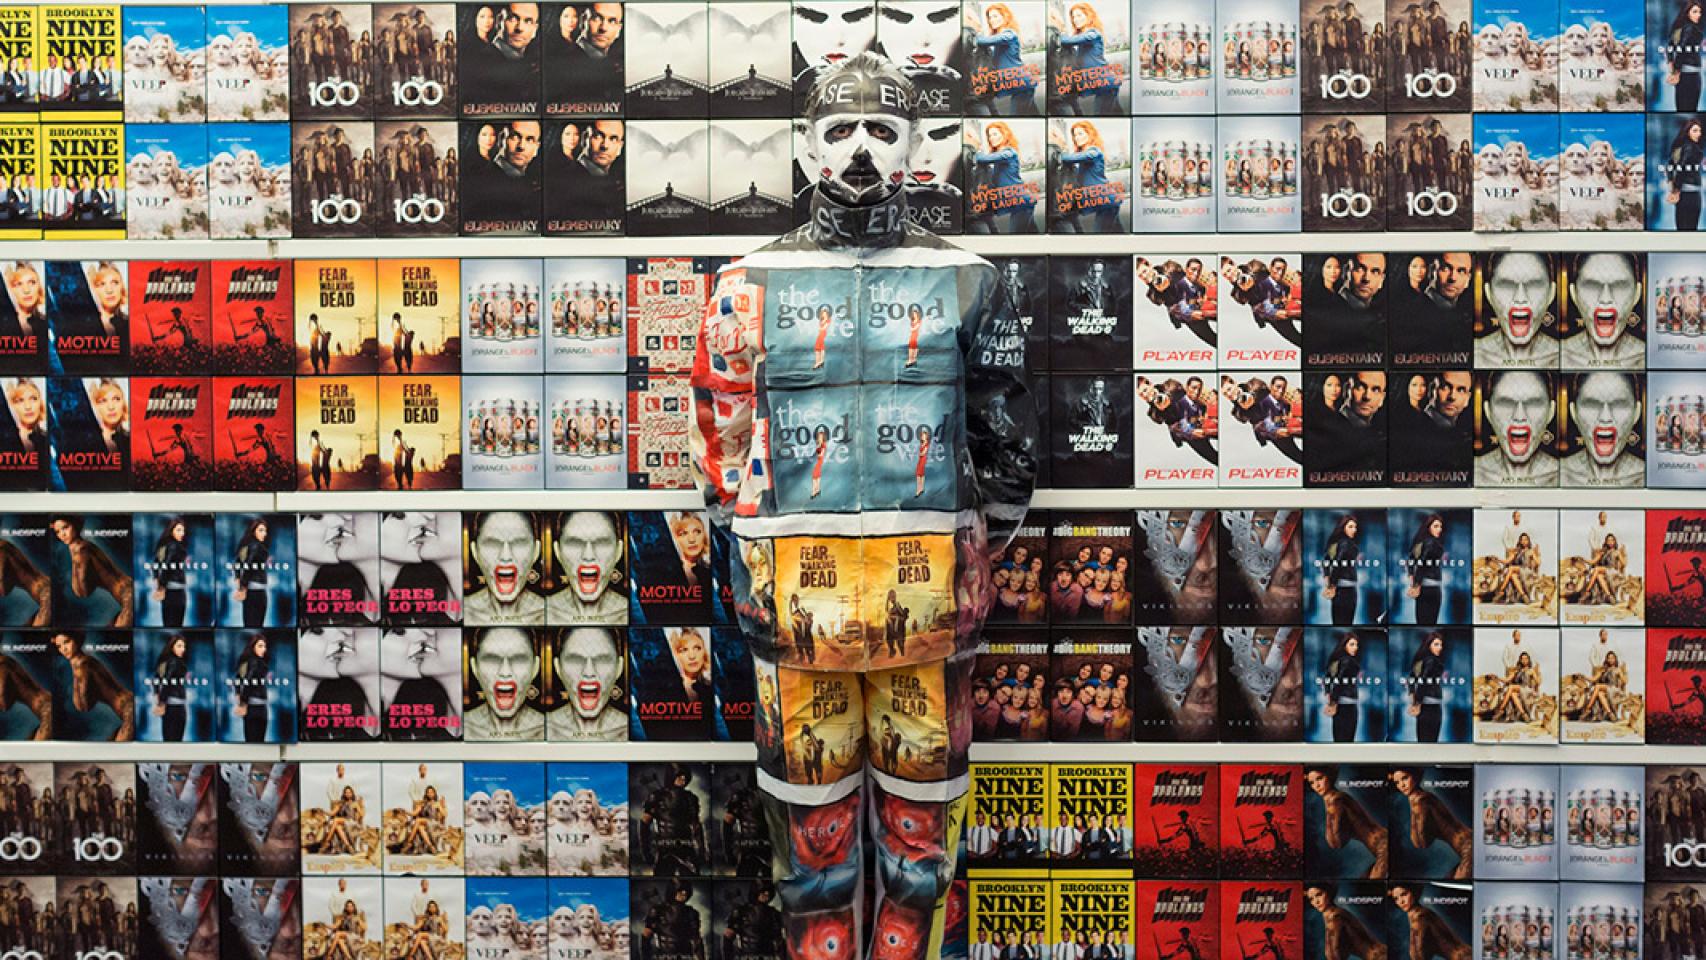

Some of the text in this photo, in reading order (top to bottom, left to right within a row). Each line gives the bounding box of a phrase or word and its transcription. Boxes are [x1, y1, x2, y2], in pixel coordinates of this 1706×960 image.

[48, 20, 115, 36] NINE
[48, 40, 115, 56] NINE
[1485, 69, 1519, 78] VEEP
[1570, 69, 1604, 78] VEEP
[132, 80, 166, 89] VEEP
[216, 79, 250, 89] VEEP
[992, 80, 1026, 91] LAURA
[1058, 80, 1109, 95] OF LAURA
[1321, 74, 1370, 99] 100
[1406, 73, 1456, 98] 100
[309, 82, 359, 106] 100
[393, 81, 443, 106] 100
[464, 102, 536, 114] ELEMENTARY
[546, 102, 621, 114] ELEMENTARY
[49, 128, 117, 136] BROOKLYN
[50, 139, 118, 155] NINE
[50, 159, 118, 176] NINE
[1485, 188, 1519, 197] VEEP
[1570, 187, 1605, 197] VEEP
[136, 198, 169, 207] VEEP
[219, 196, 252, 205] VEEP
[993, 197, 1026, 209] LAURA
[1057, 197, 1110, 213] OF LAURA
[1321, 192, 1371, 218] 100
[1407, 192, 1457, 217] 100
[311, 199, 361, 224] 100
[395, 199, 445, 224] 100
[464, 220, 538, 232] ELEMENTARY
[547, 220, 621, 232] ELEMENTARY
[319, 268, 347, 280] FEAR
[402, 267, 430, 280] FEAR
[320, 281, 354, 290] WALKING
[403, 281, 437, 290] WALKING
[320, 291, 355, 307] DEAD
[403, 291, 437, 307] DEAD
[778, 284, 819, 305] the
[777, 297, 853, 329] good
[869, 298, 944, 328] good
[993, 320, 1018, 333] THE
[1067, 317, 1117, 325] WALKING
[1072, 326, 1102, 334] DEAD
[58, 336, 120, 348] MOTIVE
[1143, 350, 1212, 361] PLAYER
[1227, 350, 1297, 360] PLAYER
[1308, 352, 1383, 364] ELEMENTARY
[1394, 352, 1468, 364] ELEMENTARY
[320, 384, 348, 397] FEAR
[403, 384, 431, 397] FEAR
[320, 399, 355, 407] WALKING
[404, 399, 438, 407] WALKING
[321, 408, 355, 424] DEAD
[404, 408, 438, 423] DEAD
[776, 413, 851, 459] good
[877, 413, 949, 453] good
[1069, 434, 1119, 443] WALKING
[1073, 443, 1103, 451] DEAD
[59, 453, 121, 465] MOTIVE
[1145, 469, 1214, 479] PLAYER
[1229, 469, 1298, 479] PLAYER
[1310, 471, 1384, 483] ELEMENTARY
[1393, 471, 1468, 483] ELEMENTARY
[84, 529, 128, 537] BLINDSPOT
[801, 546, 828, 560] FEAR
[897, 541, 921, 555] FEAR
[801, 561, 836, 570] WALKING
[800, 571, 837, 588] DEAD
[898, 566, 930, 584] DEAD
[307, 589, 352, 600] ERES
[389, 589, 434, 600] ERES
[641, 586, 702, 598] MOTIVE
[307, 602, 378, 613] LO PEOR
[389, 601, 460, 612] LO PEOR
[813, 681, 842, 693] FEAR
[892, 675, 920, 689] FEAR
[307, 704, 352, 715] ERES
[389, 704, 434, 715] ERES
[641, 703, 702, 715] MOTIVE
[813, 700, 848, 719] DEAD
[893, 699, 927, 716] DEAD
[307, 717, 378, 728] LO PEOR
[389, 716, 460, 728] LO PEOR
[975, 768, 1043, 776] BROOKLYN
[1058, 768, 1126, 776] BROOKLYN
[975, 778, 1044, 795] NINE
[1058, 778, 1127, 795] NINE
[975, 799, 1044, 814] NINE
[1058, 799, 1127, 814] NINE
[475, 834, 507, 844] VEEP
[557, 834, 589, 844] VEEP
[73, 837, 123, 861] 100
[977, 884, 1045, 892] BROOKLYN
[1060, 884, 1128, 892] BROOKLYN
[977, 895, 1045, 912] NINE
[1061, 895, 1129, 912] NINE
[977, 915, 1045, 931] NINE
[1061, 915, 1129, 931] NINE
